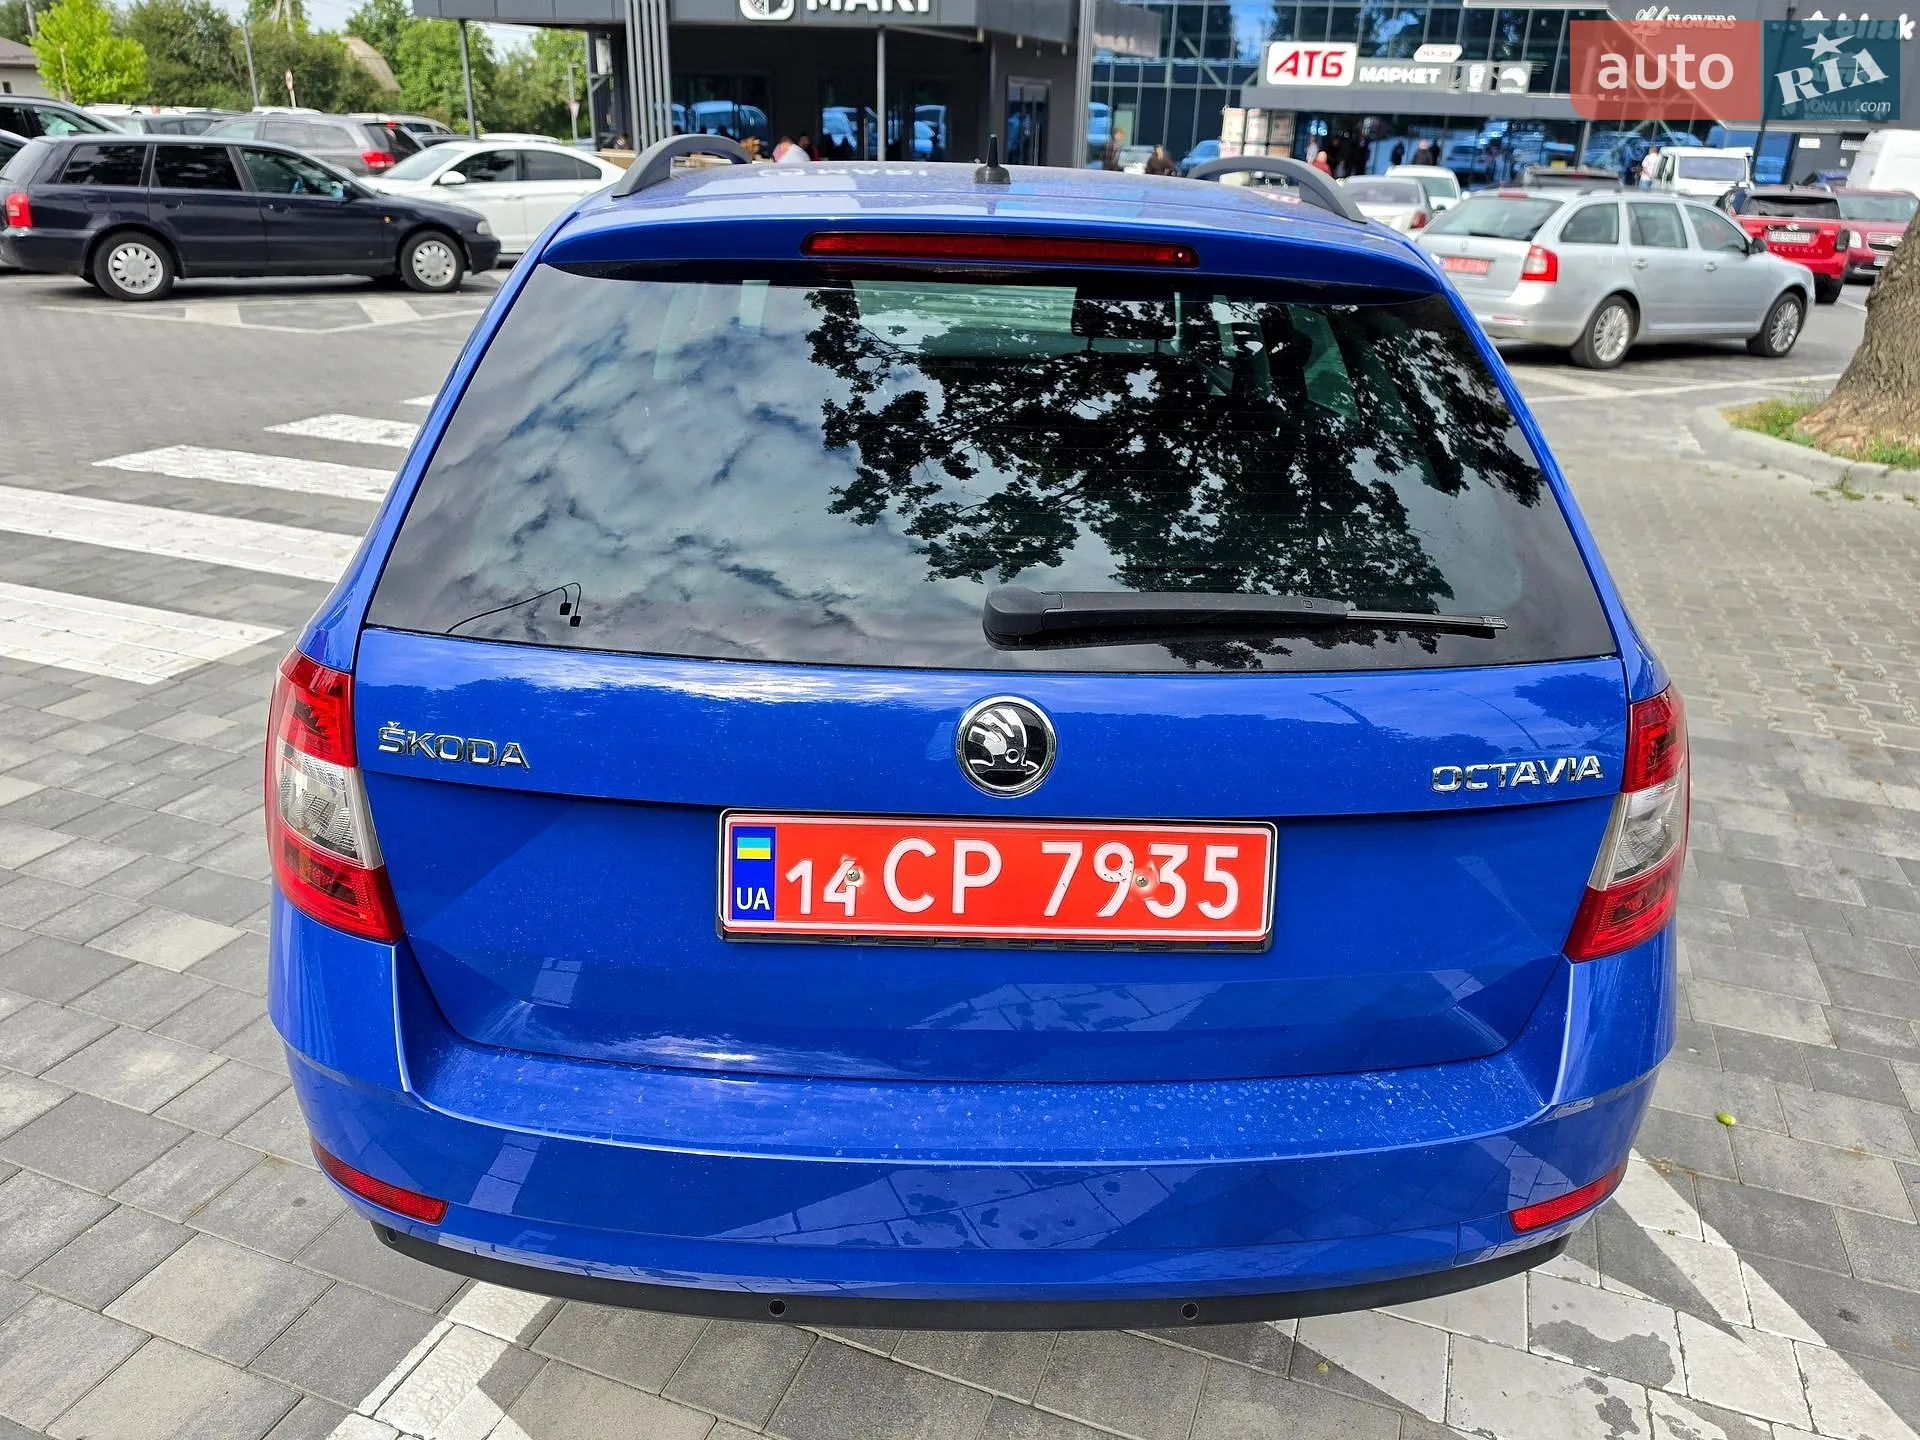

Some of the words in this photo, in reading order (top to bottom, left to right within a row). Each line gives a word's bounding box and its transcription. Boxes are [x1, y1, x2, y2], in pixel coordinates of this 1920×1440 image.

[1274, 50, 1348, 78] АТБ
[1359, 66, 1441, 84] МАРКЕТ
[379, 721, 530, 770] ŠKODA
[1432, 754, 1604, 792] OCTAVIA
[785, 857, 858, 917] 14
[882, 836, 1002, 914] CP
[1041, 842, 1240, 918] 7935
[735, 886, 771, 911] UA
